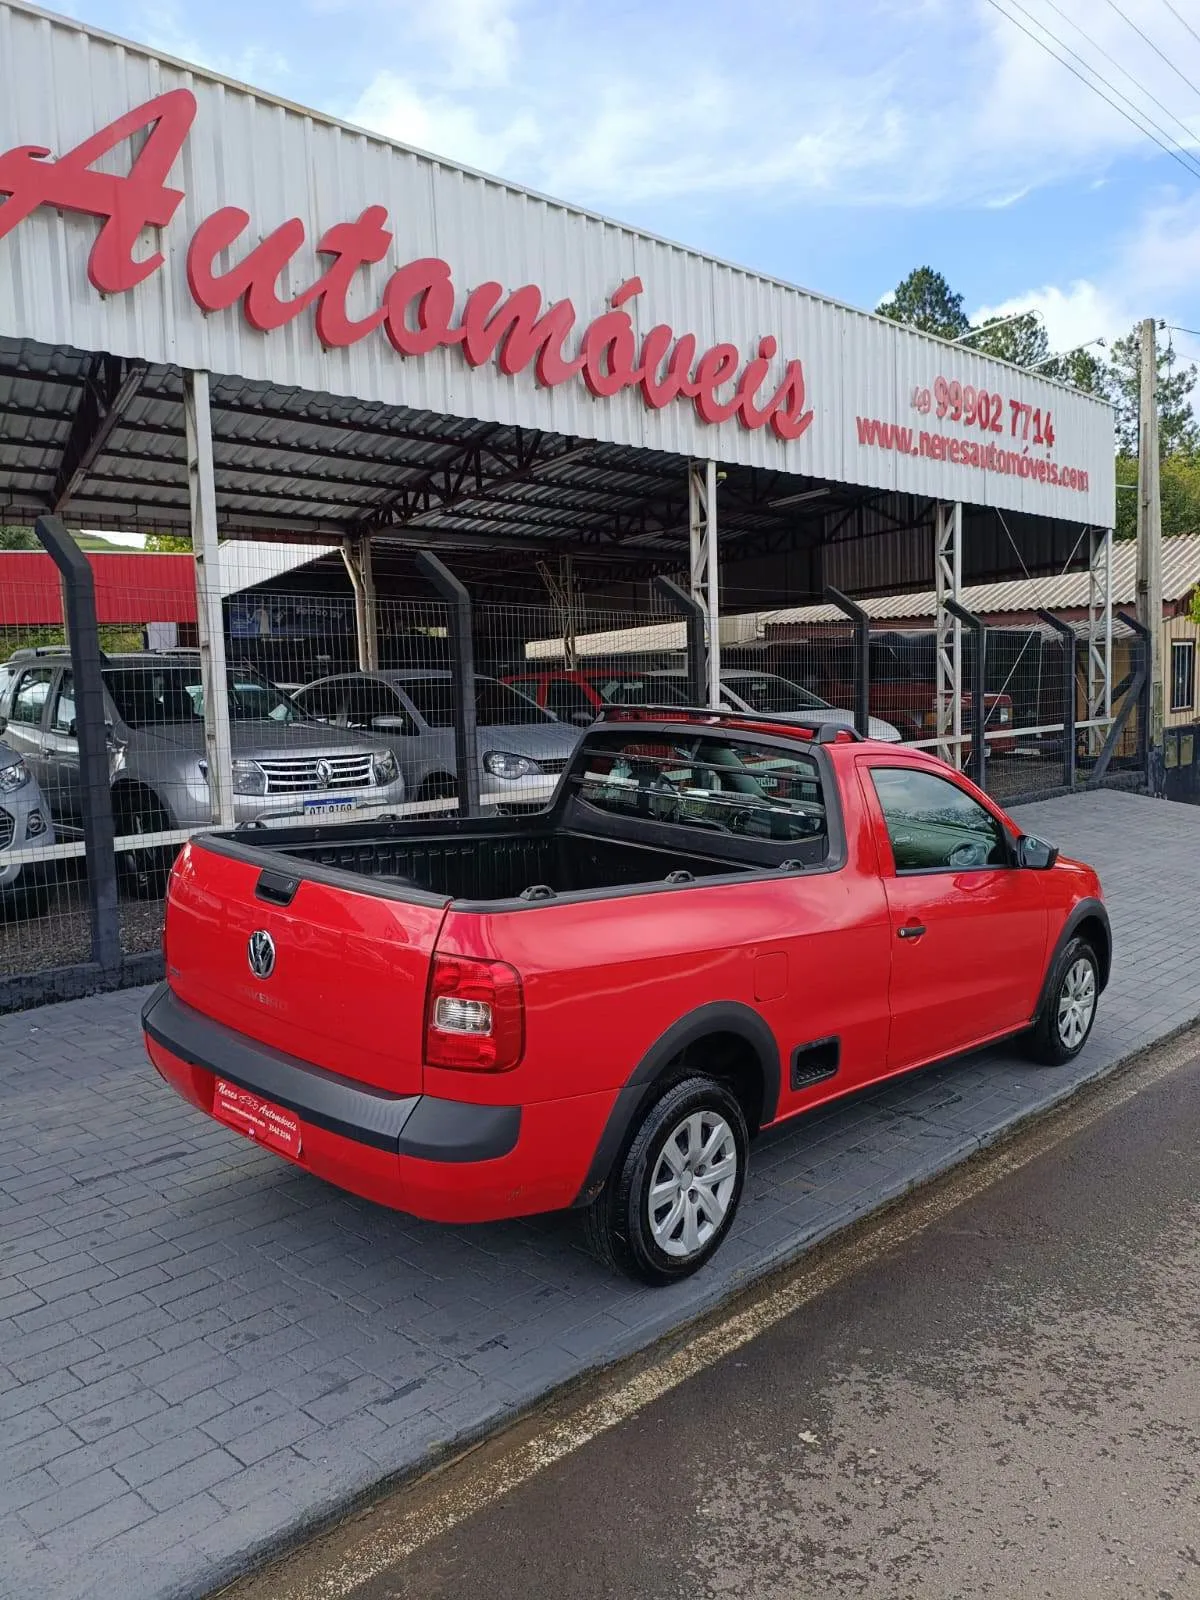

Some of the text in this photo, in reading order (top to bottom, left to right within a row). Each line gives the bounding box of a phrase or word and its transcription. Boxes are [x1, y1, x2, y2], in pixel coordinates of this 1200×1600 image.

[0, 88, 814, 440] Automóveis
[934, 375, 1003, 432] 99902
[1009, 399, 1055, 448] 7714
[856, 416, 1089, 492] www.neresautomóveis.com
